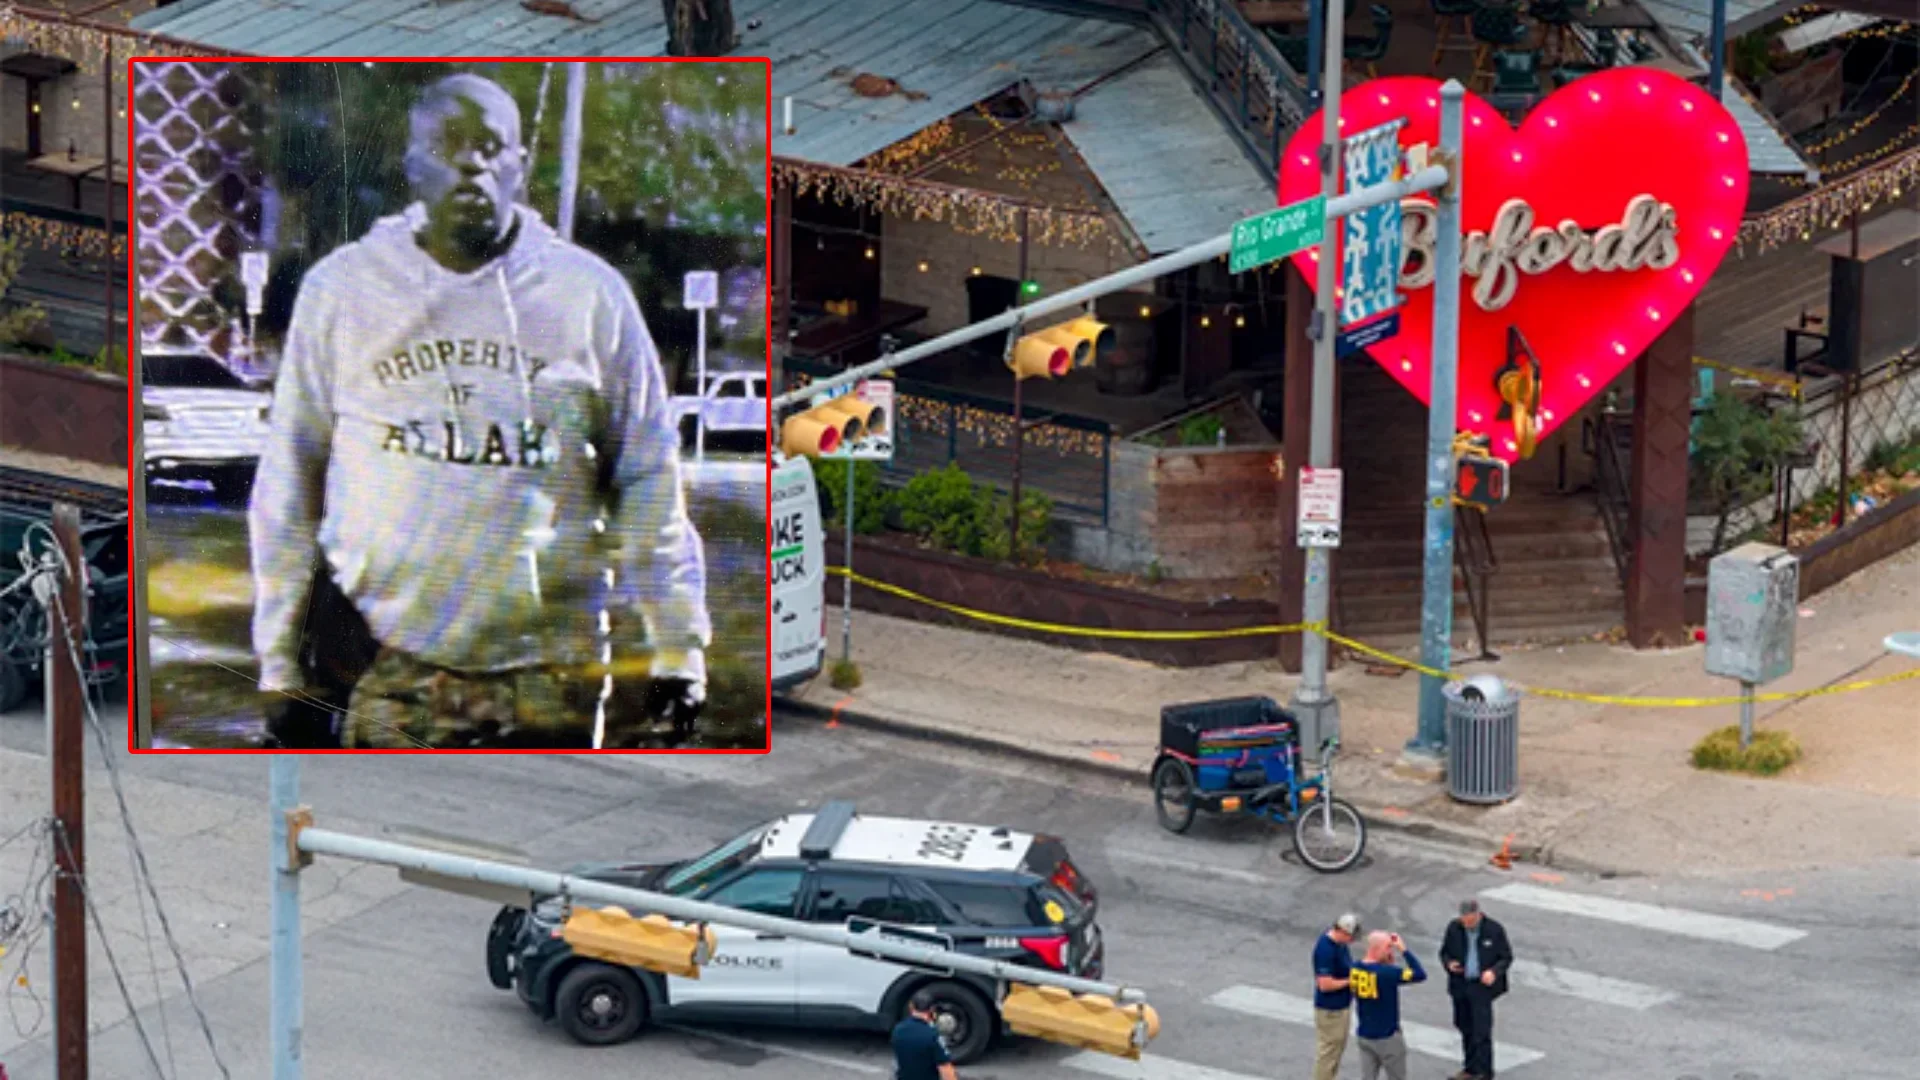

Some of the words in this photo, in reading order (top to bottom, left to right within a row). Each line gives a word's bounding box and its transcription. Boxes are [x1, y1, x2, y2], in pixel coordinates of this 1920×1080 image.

[1237, 224, 1258, 248] Rio
[1260, 208, 1307, 241] Grande
[1397, 193, 1679, 311] Buford's
[373, 338, 547, 388] PROPERTY
[771, 512, 804, 547] KE
[711, 953, 783, 971] OLICE
[1349, 967, 1378, 999] FBI
